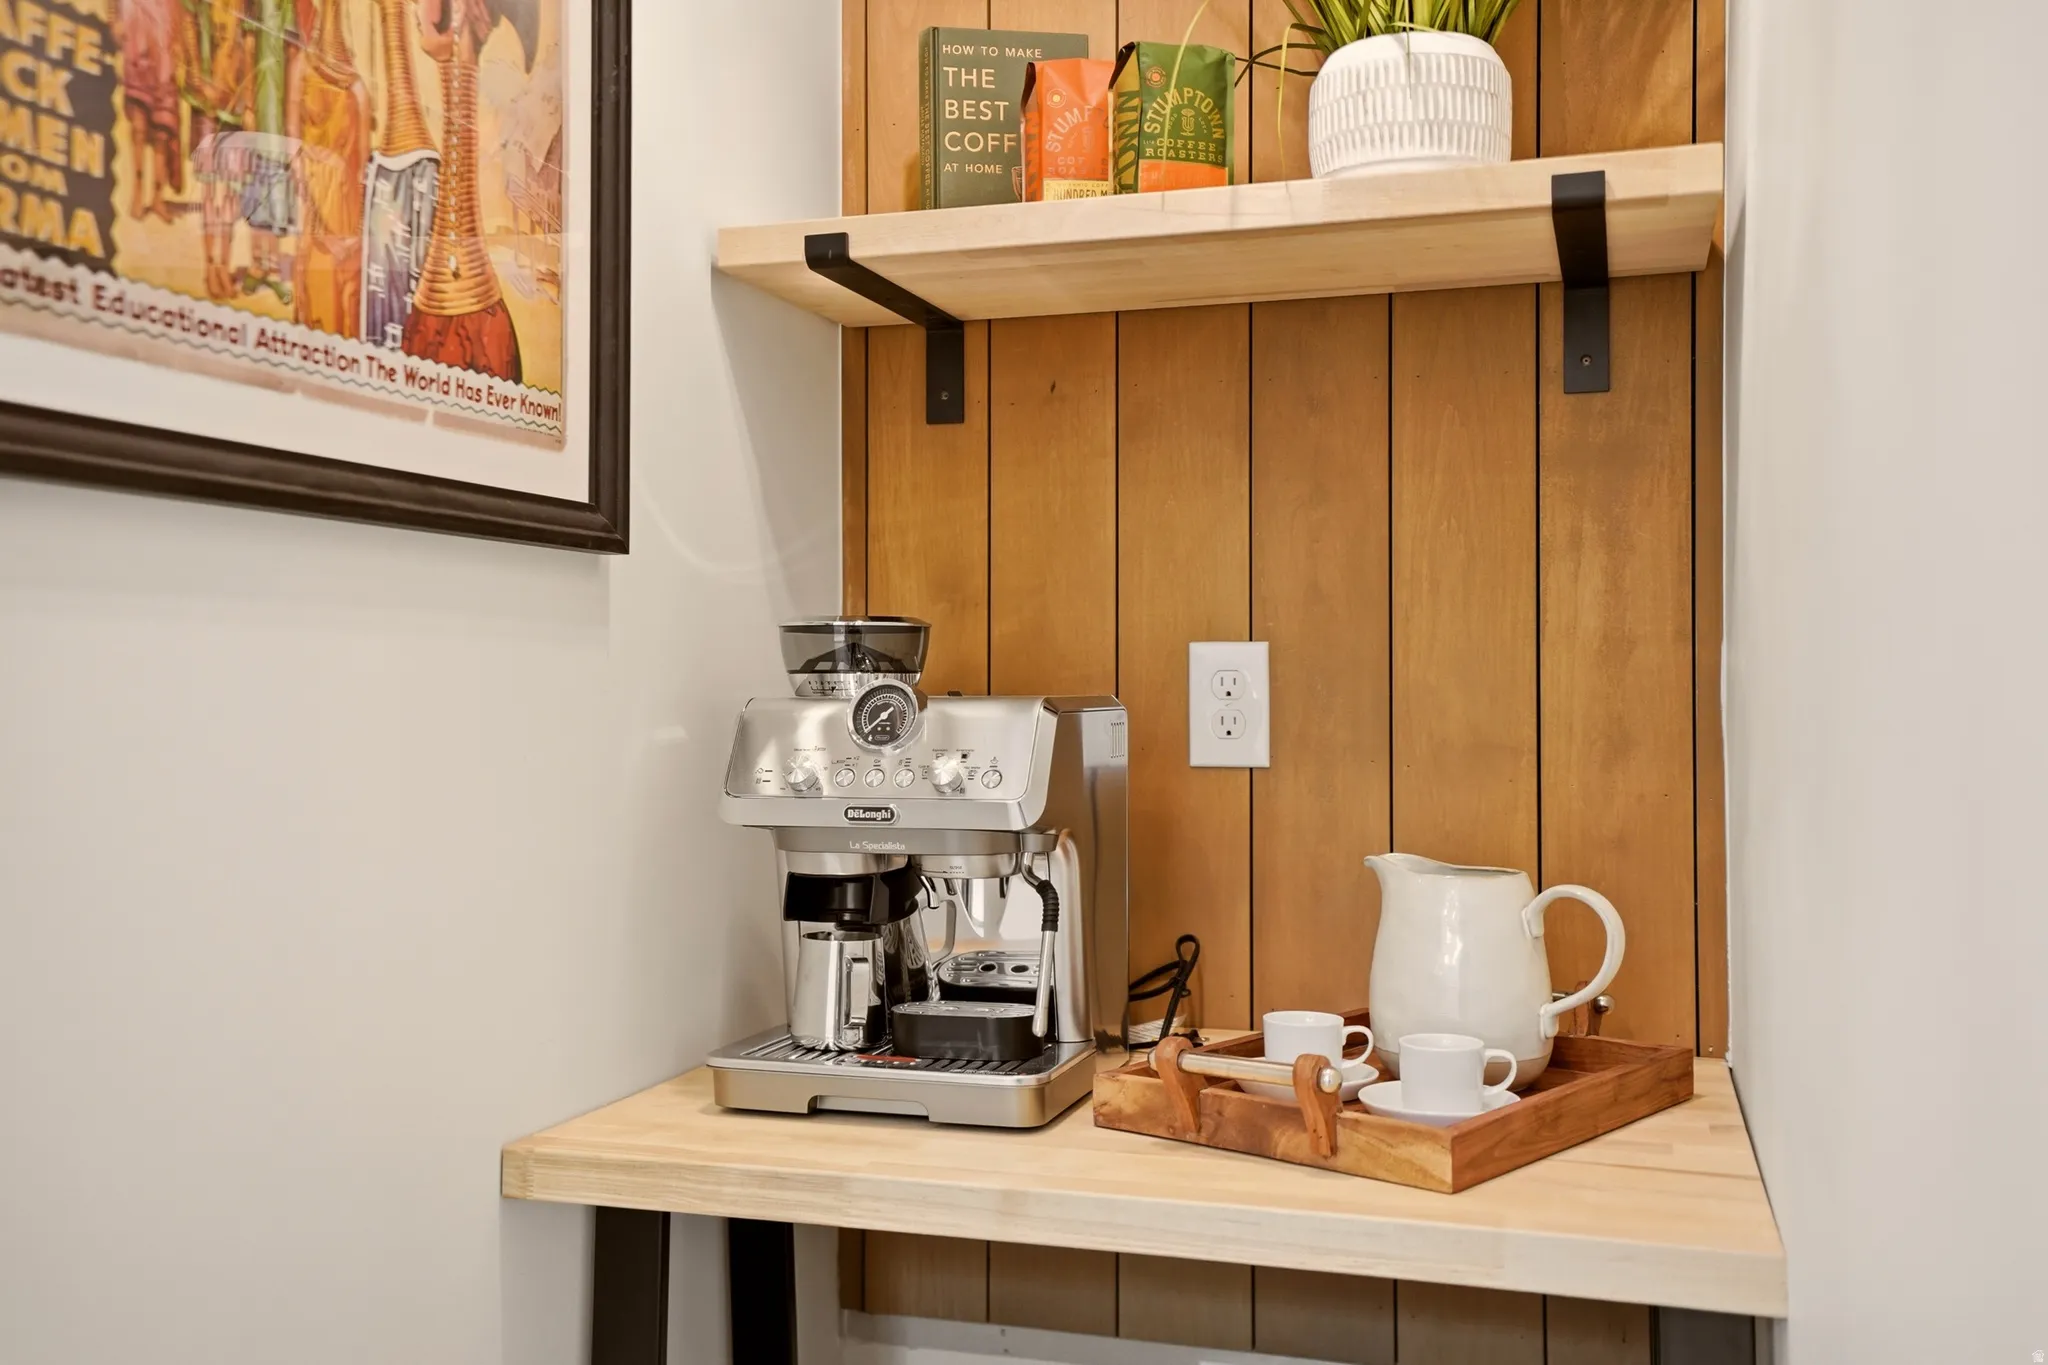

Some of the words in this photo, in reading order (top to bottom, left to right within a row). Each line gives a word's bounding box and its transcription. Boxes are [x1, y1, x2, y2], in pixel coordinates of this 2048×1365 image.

[942, 44, 974, 55] HOW
[981, 46, 998, 57] TO
[1005, 47, 1042, 58] MAKE
[943, 66, 996, 89] THE
[945, 99, 1010, 121] BEST
[1144, 87, 1225, 140] STUMPTOWN
[1156, 138, 1216, 152] COFFEE
[1146, 148, 1224, 163] ROASTERS
[944, 163, 959, 173] AT
[965, 163, 1003, 174] HOME
[93, 284, 248, 346] Educational
[255, 327, 361, 375] Attraction
[366, 355, 398, 383] The
[403, 364, 451, 396] World
[456, 379, 482, 403] Has
[487, 386, 517, 410] Ever
[520, 393, 562, 422] Known!
[849, 841, 860, 849] La
[862, 841, 906, 851] Specialista
